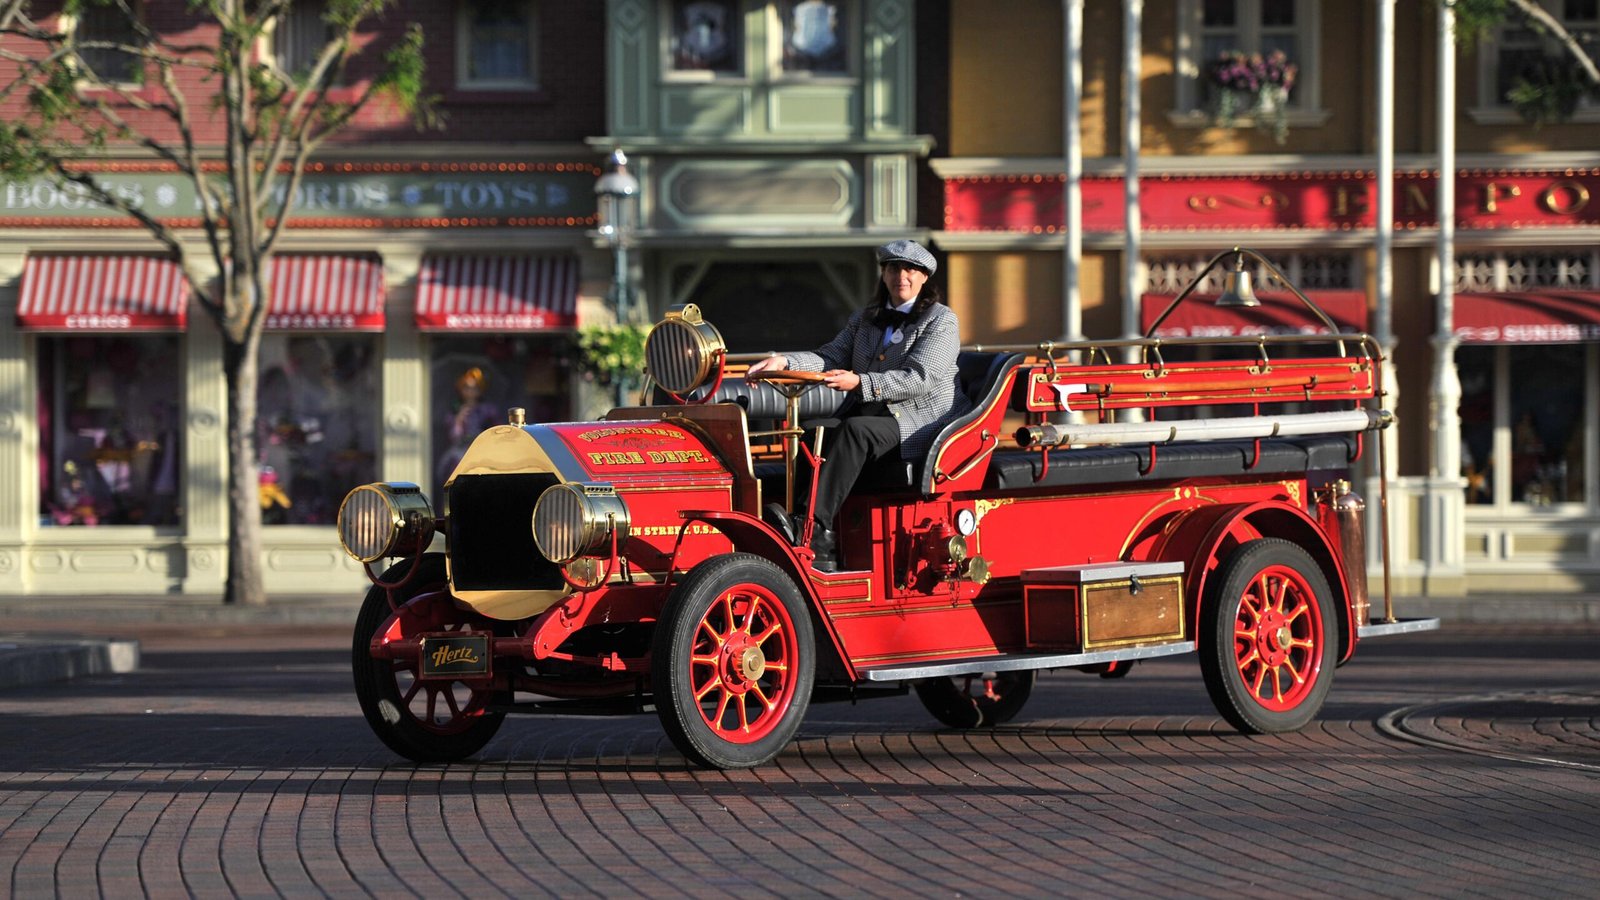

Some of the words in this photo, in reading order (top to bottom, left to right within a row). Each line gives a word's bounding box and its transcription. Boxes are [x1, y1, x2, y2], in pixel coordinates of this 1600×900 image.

[434, 181, 538, 209] TOYS
[578, 427, 686, 442] VOLUNTEER
[588, 451, 646, 465] FIRE
[647, 450, 709, 464] DEPT.
[432, 645, 478, 667] Hertz
